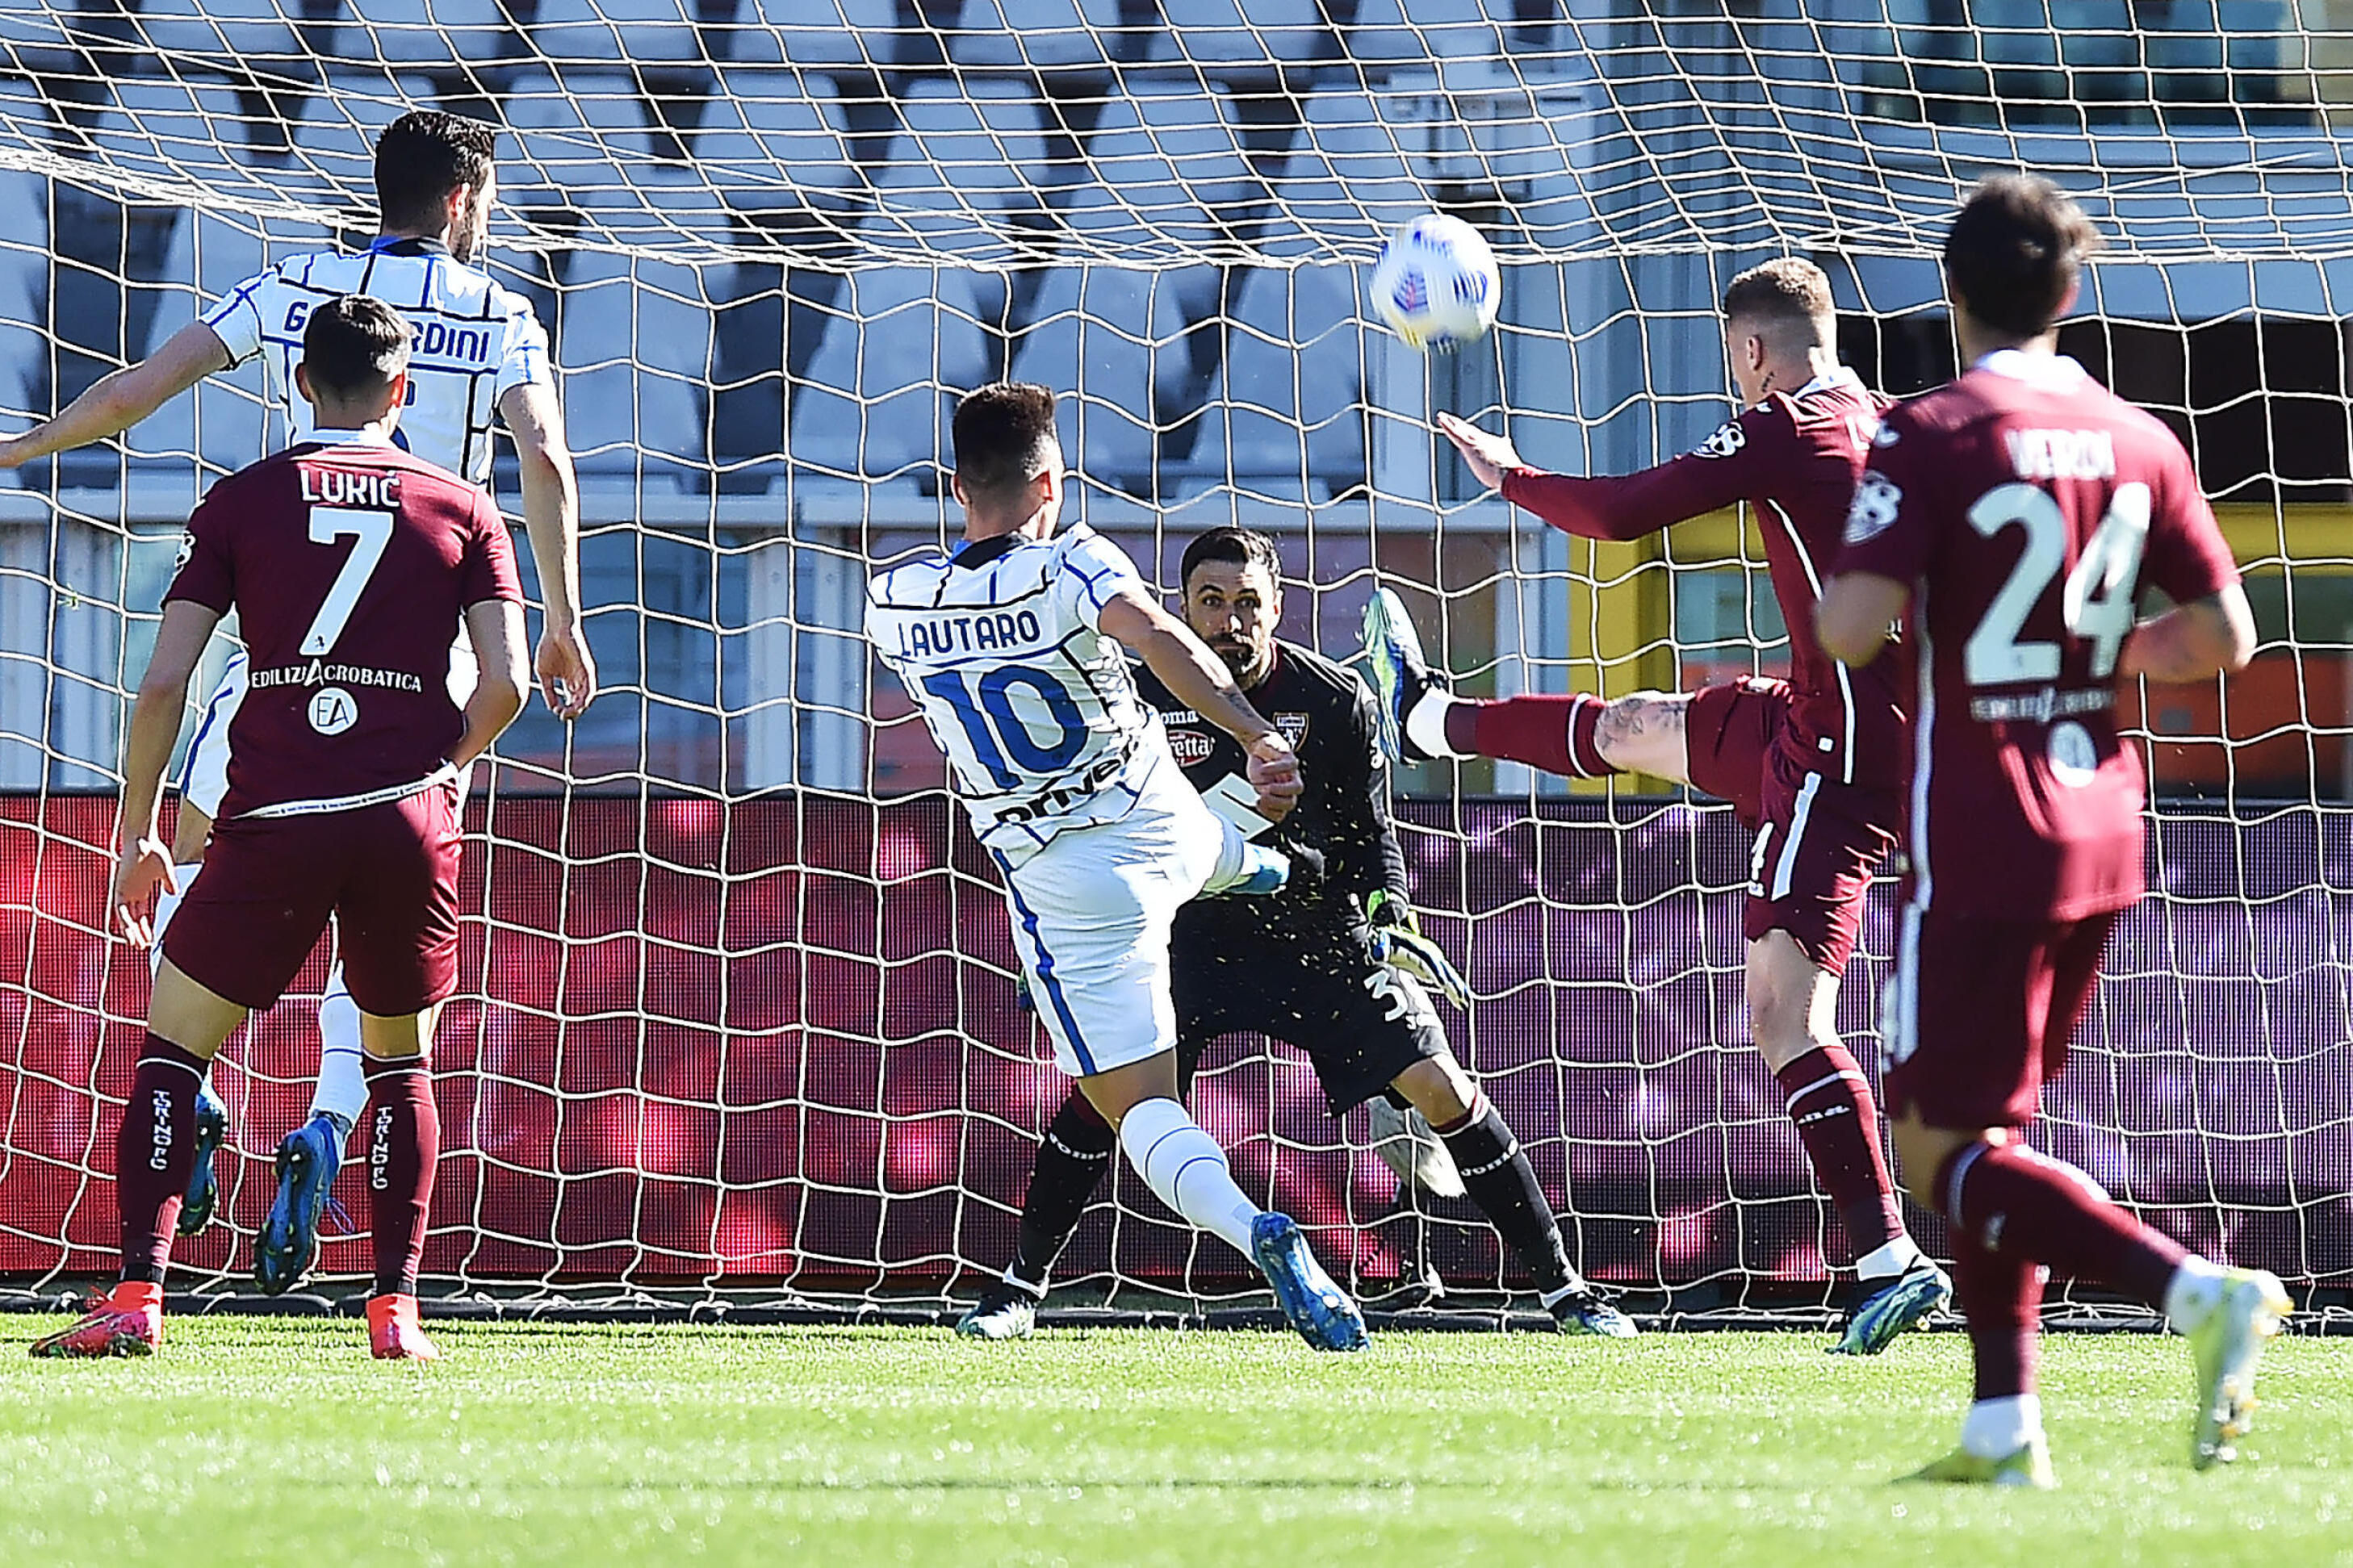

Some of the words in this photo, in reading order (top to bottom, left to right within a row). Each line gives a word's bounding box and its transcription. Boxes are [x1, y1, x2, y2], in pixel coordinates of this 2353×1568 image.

[284, 301, 490, 363] GRDINI
[299, 469, 401, 508] LUKIĆ
[299, 506, 395, 656] 7
[1963, 481, 2150, 685] 24
[898, 609, 1040, 658] LAUTARO
[251, 658, 423, 694] EDILIZIACROBATICA
[920, 664, 1091, 790] 10
[1160, 710, 1200, 725] oma
